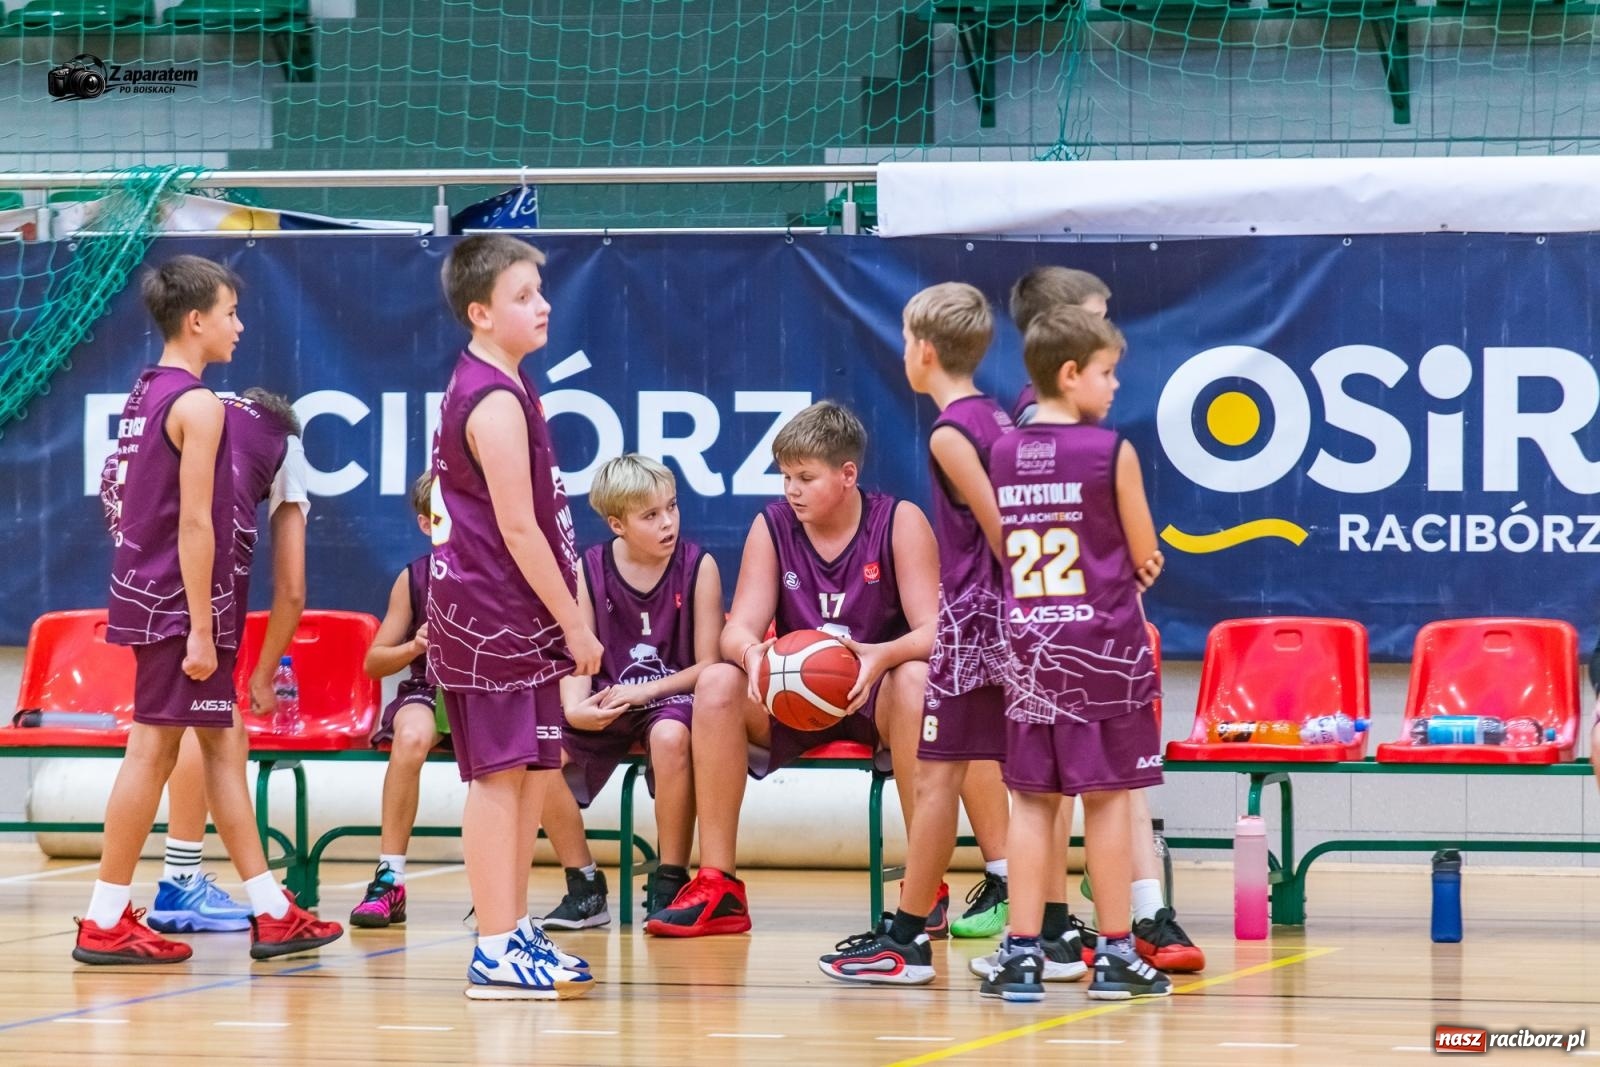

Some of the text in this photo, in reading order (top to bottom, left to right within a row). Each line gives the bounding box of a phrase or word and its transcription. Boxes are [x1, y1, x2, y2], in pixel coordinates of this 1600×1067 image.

[1156, 344, 1600, 495] OSiR
[998, 482, 1083, 508] KRZYSTOLIK
[1339, 501, 1600, 553] RACIBÓRZ
[1006, 528, 1086, 598] 22
[819, 592, 846, 618] 17
[640, 612, 651, 635] 1
[923, 715, 938, 742] 6
